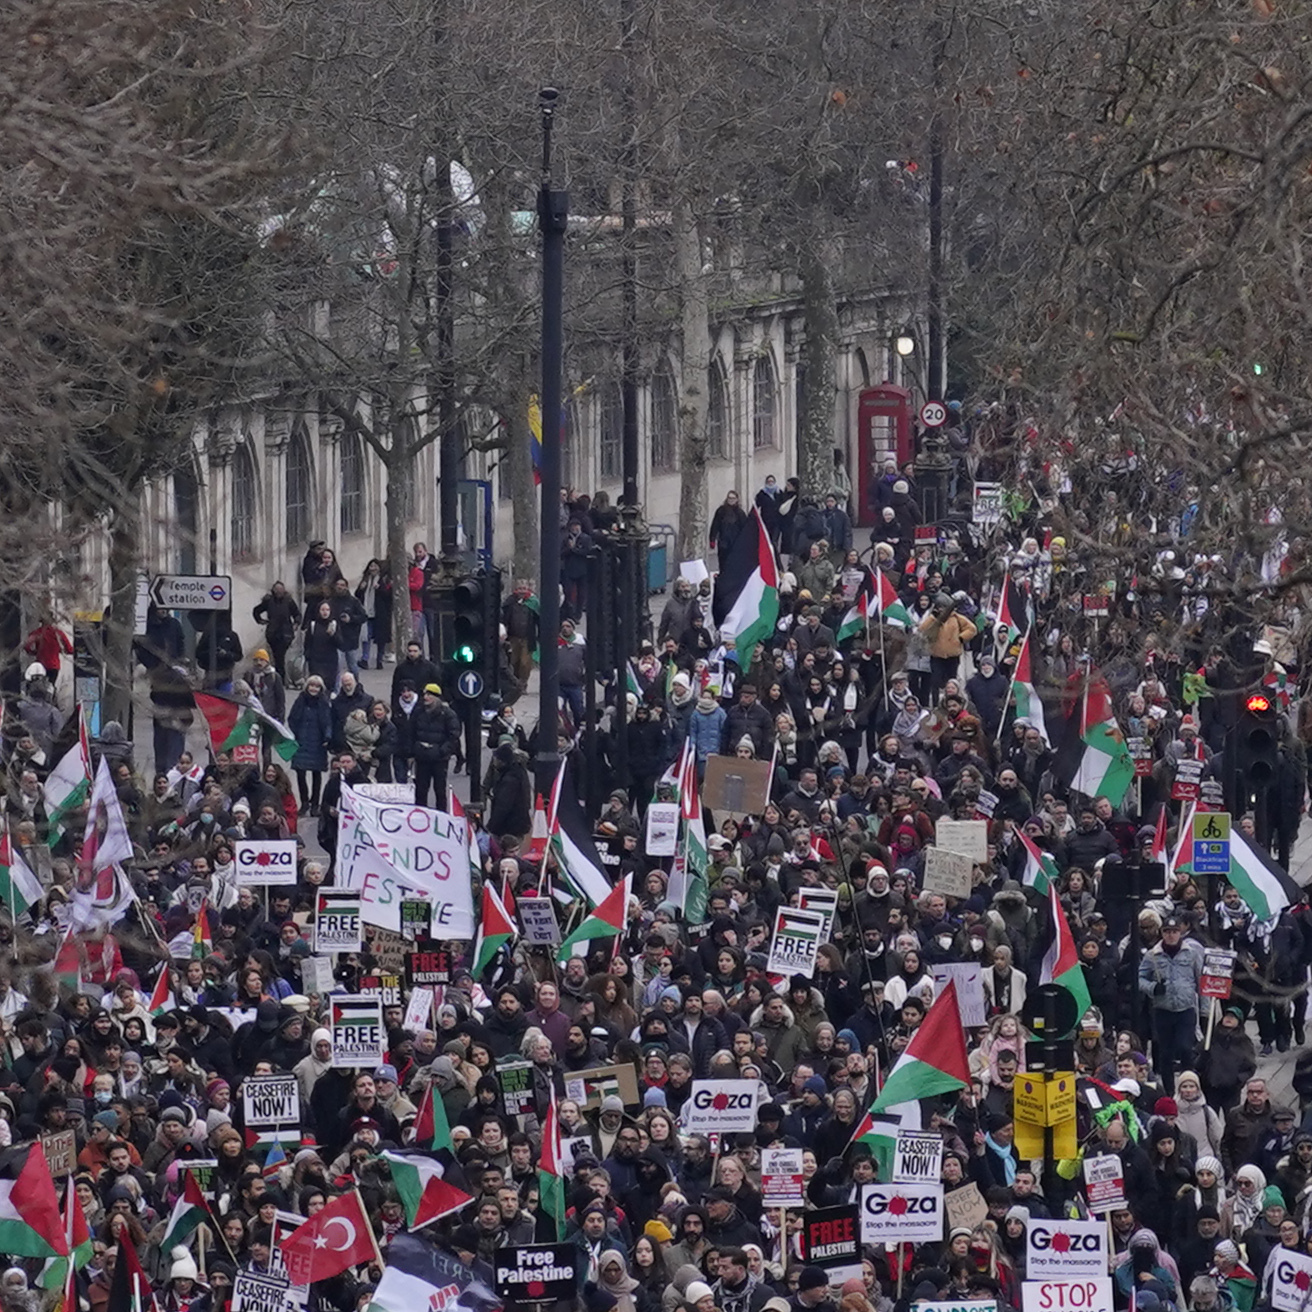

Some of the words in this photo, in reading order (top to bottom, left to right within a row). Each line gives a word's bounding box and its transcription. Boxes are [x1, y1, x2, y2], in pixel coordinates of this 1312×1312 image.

[169, 581, 206, 592] Temple
[169, 593, 206, 604] station
[318, 915, 359, 931] FREE
[774, 935, 816, 958] FREE
[411, 953, 448, 972] FREE
[332, 1026, 380, 1044] FREE
[332, 1043, 380, 1053] PALESTINE
[245, 1082, 296, 1098] CEASEFIRE
[898, 1139, 941, 1157] CEASEFIRE
[865, 1193, 937, 1215] Gza
[809, 1217, 854, 1247] FREE
[899, 1220, 937, 1228] massacre
[1030, 1227, 1101, 1252] Gza
[516, 1250, 555, 1267] Free
[810, 1240, 857, 1260] PALESTINE
[1063, 1258, 1102, 1266] massacre
[497, 1265, 574, 1284] Palestine
[1038, 1282, 1098, 1309] STOP
